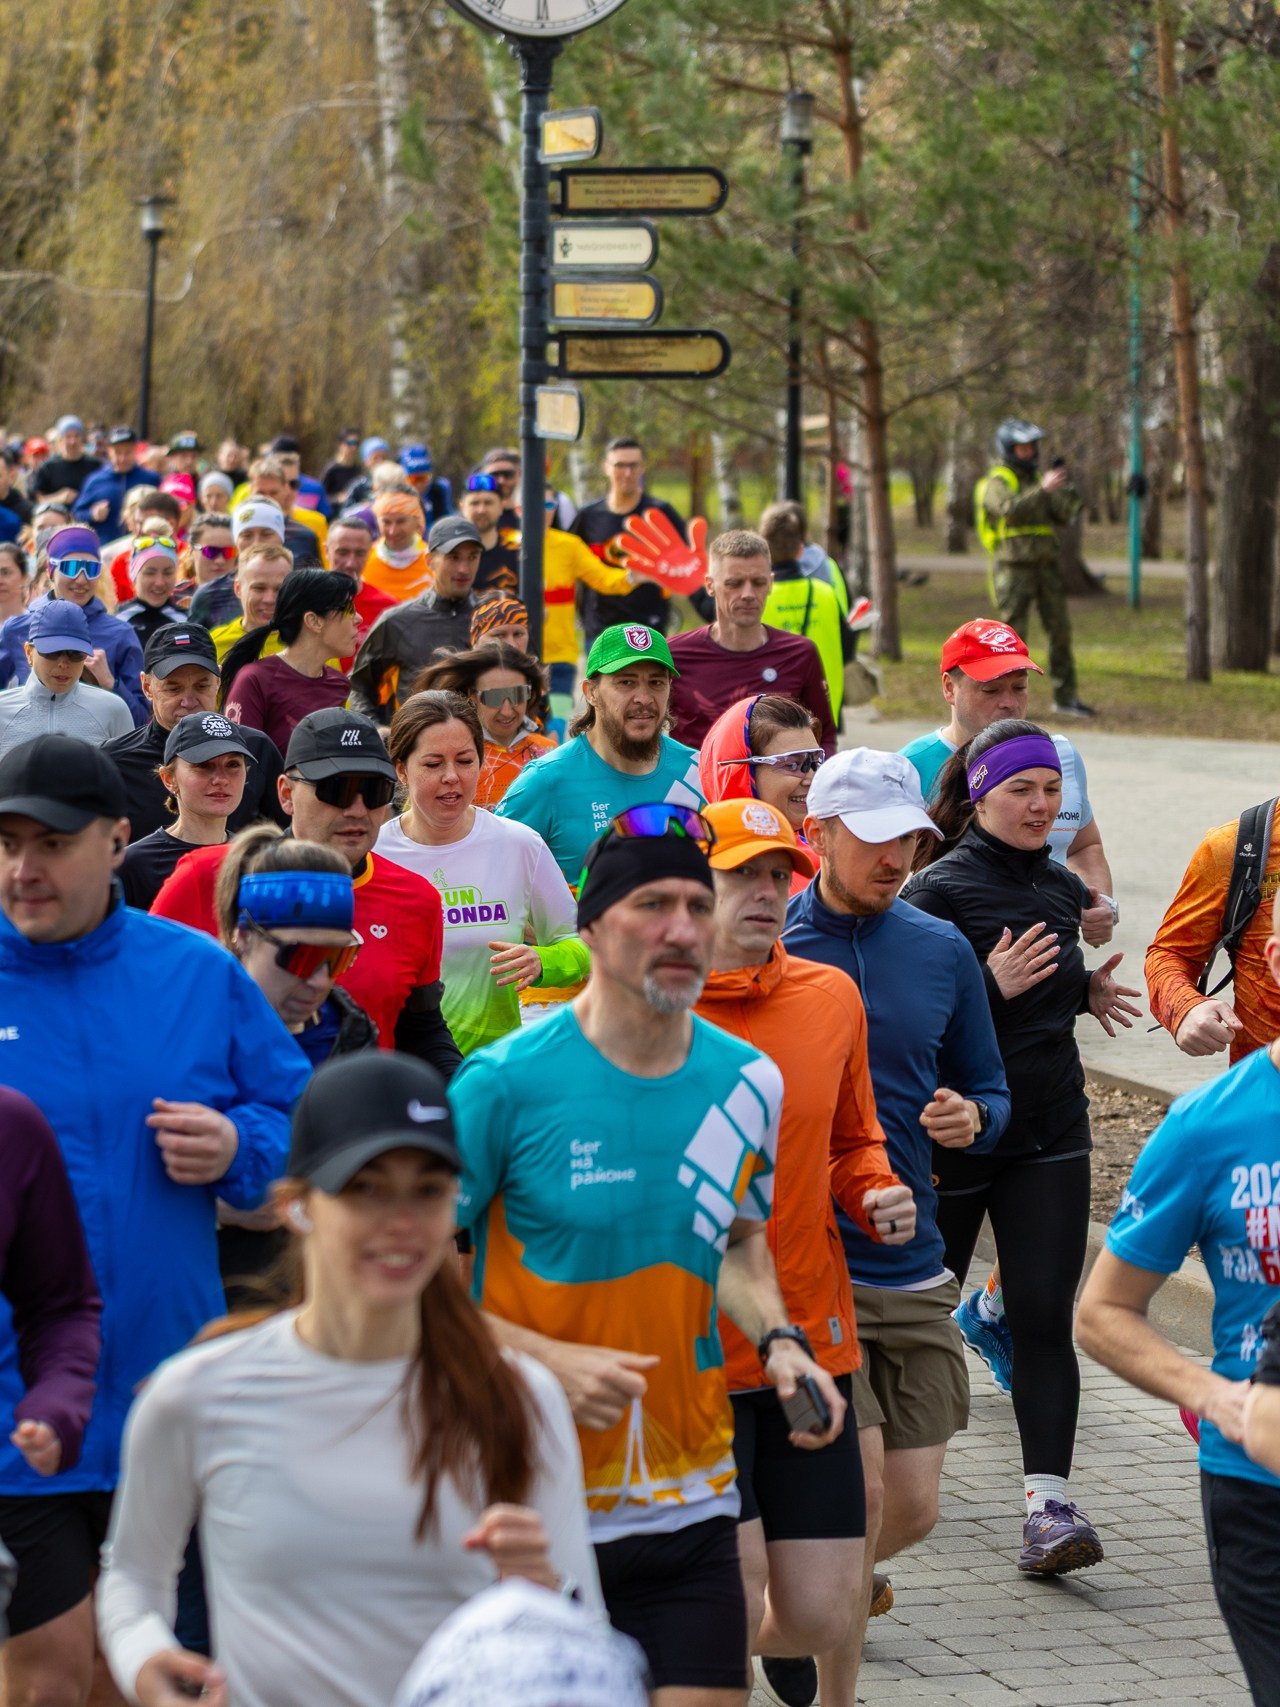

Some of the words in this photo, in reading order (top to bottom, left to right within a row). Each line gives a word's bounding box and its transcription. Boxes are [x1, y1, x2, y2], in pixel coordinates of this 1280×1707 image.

[591, 801, 610, 812] бег
[593, 811, 607, 820] на
[442, 889, 475, 907] UN
[443, 903, 507, 925] ONDA
[569, 1138, 602, 1156] бег
[569, 1156, 594, 1170] на
[570, 1167, 637, 1192] районе
